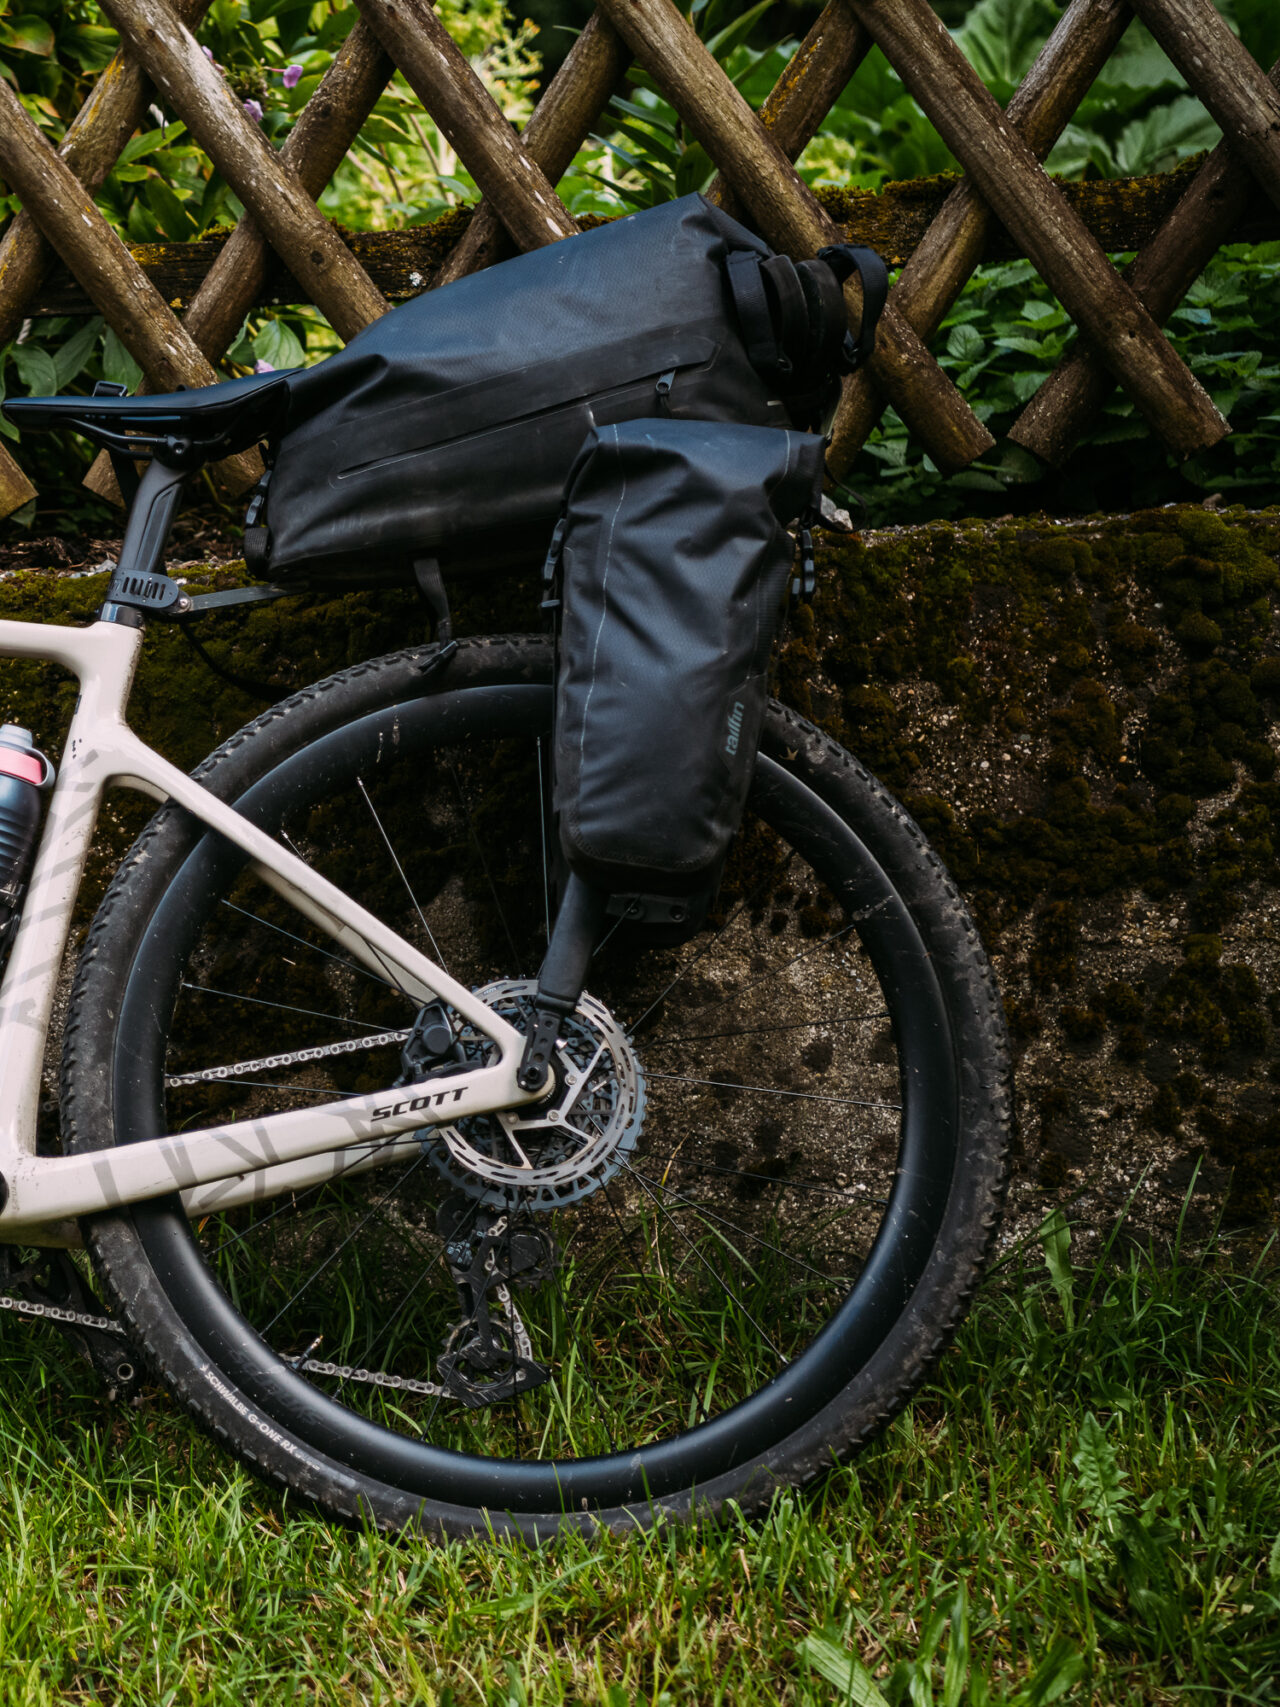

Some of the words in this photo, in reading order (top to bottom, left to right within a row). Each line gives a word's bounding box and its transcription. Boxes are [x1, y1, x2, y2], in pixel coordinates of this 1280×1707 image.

[370, 1086, 469, 1123] SCOTT
[204, 1371, 250, 1416] SCHWALBE
[247, 1413, 284, 1444] G-ONE
[280, 1438, 298, 1454] RX
